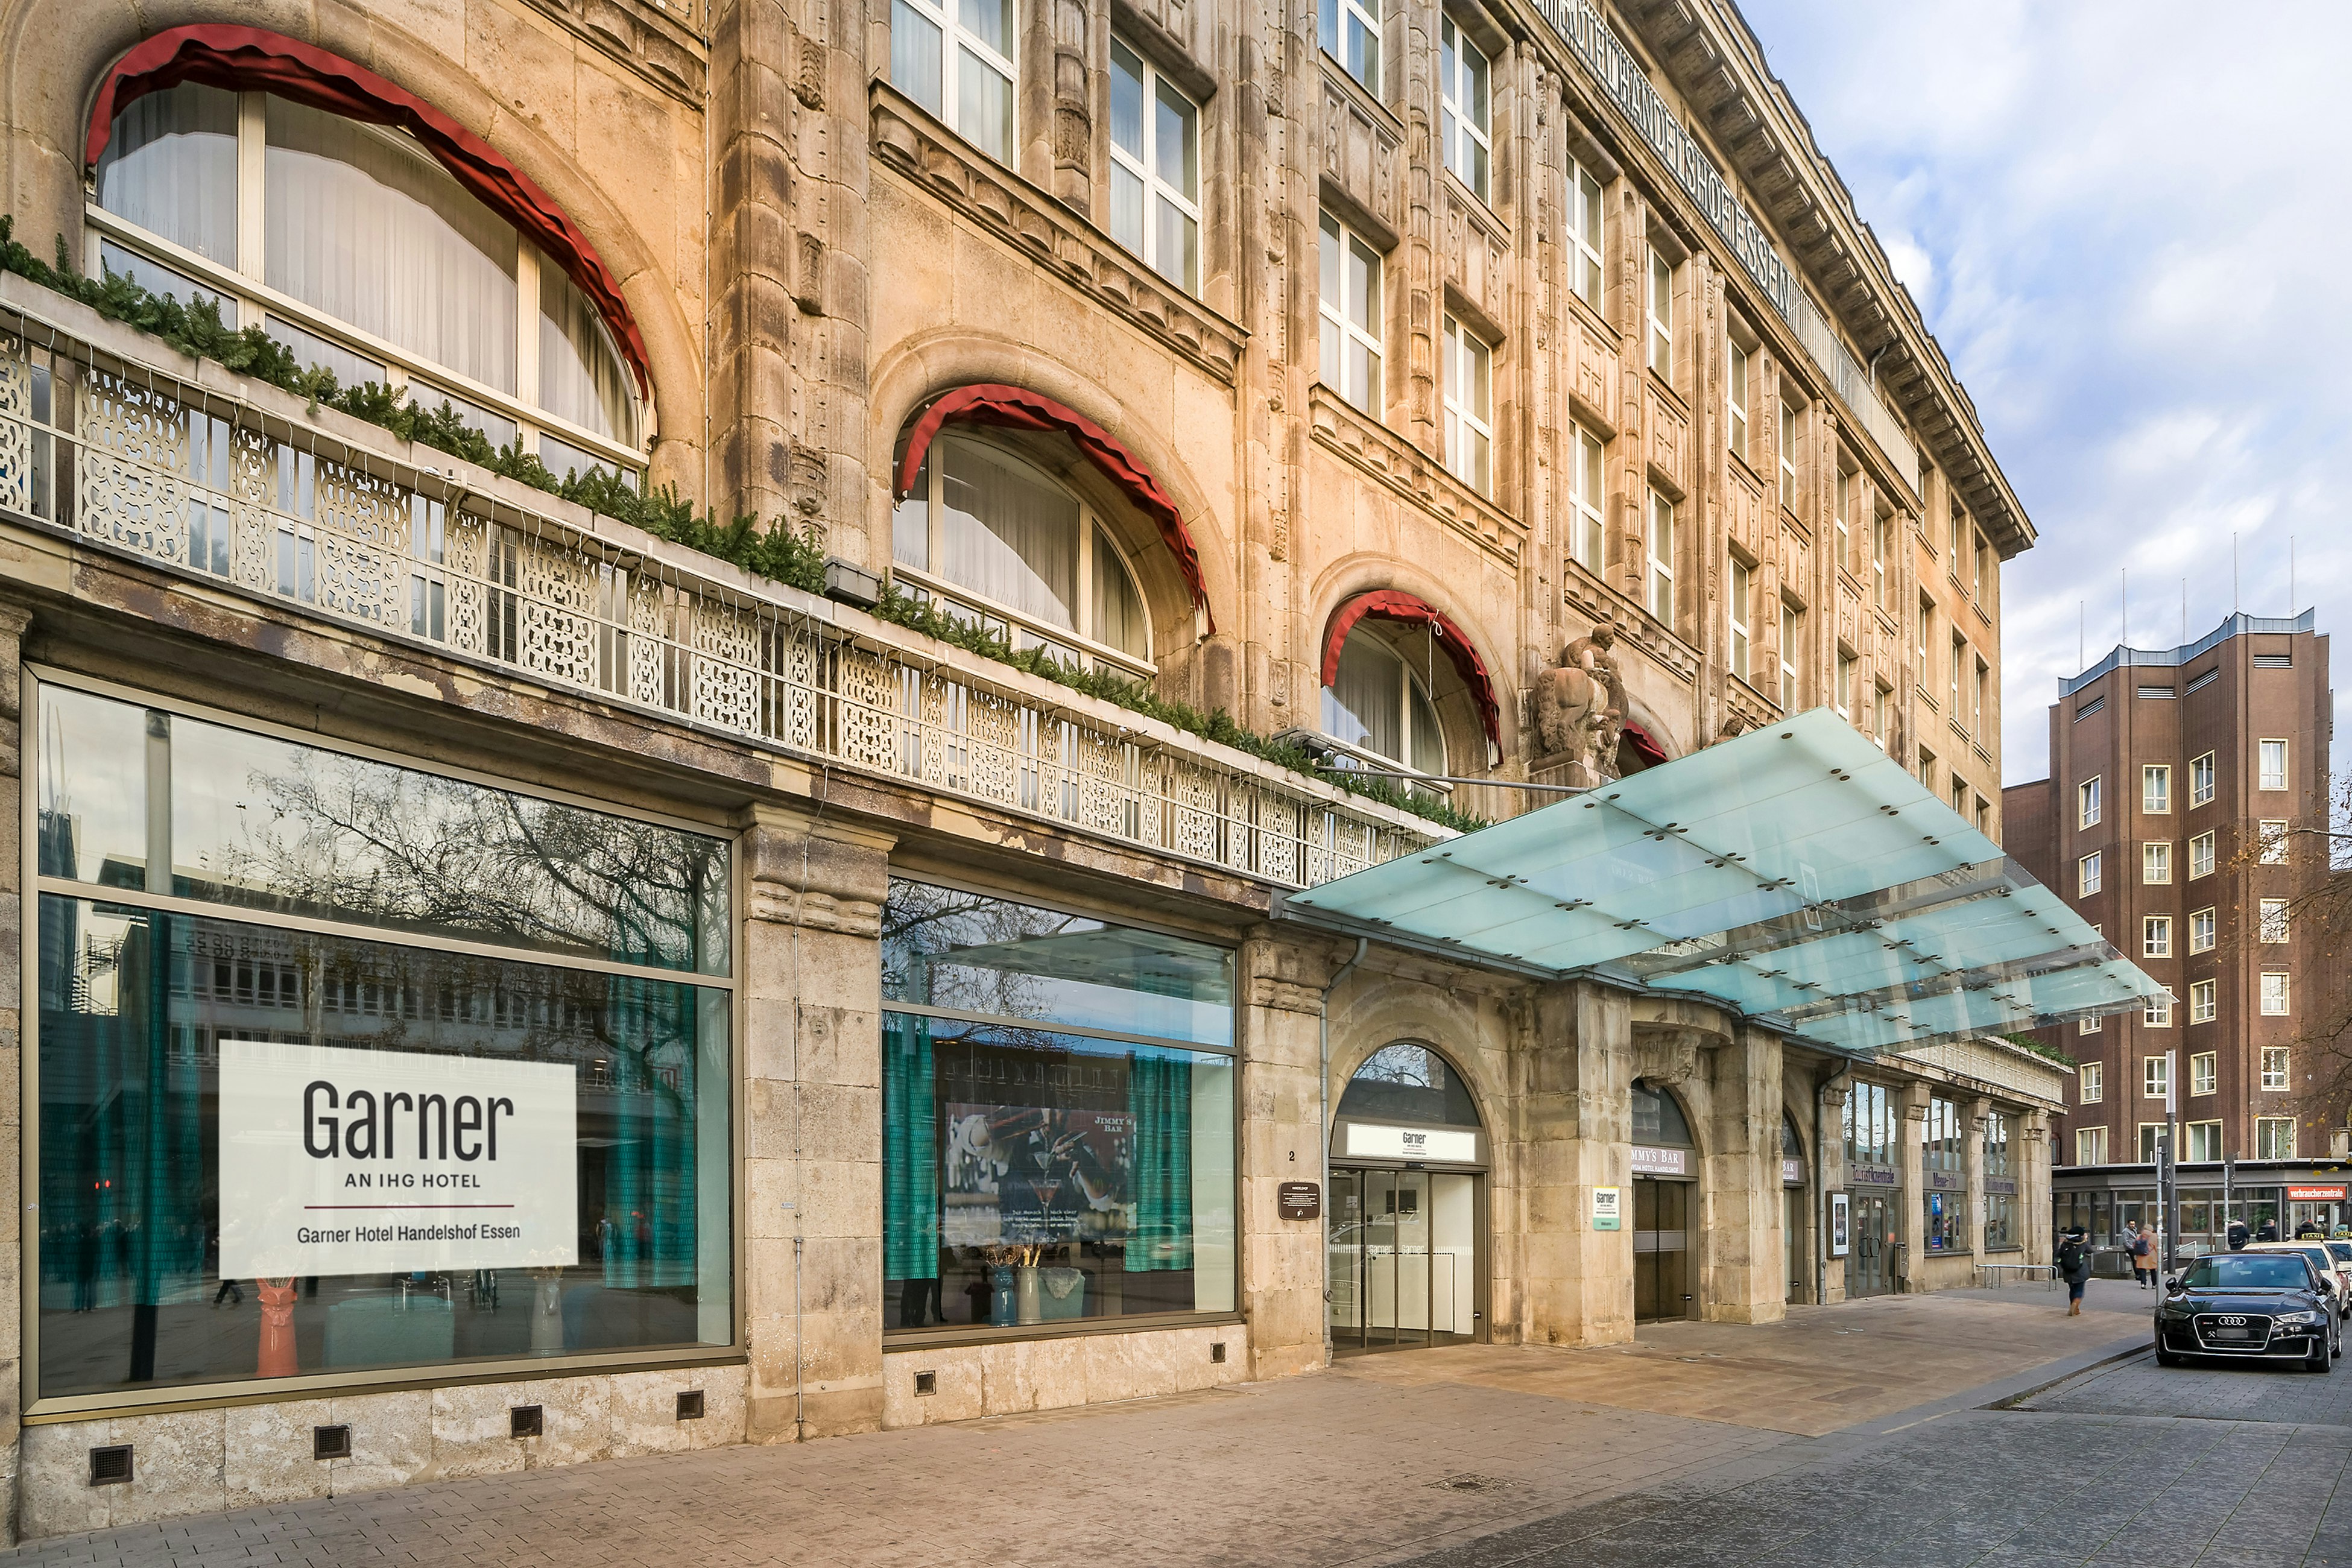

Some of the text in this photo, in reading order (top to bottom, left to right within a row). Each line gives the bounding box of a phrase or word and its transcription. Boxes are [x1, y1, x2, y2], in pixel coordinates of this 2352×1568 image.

[1619, 52, 1731, 236] HANDELSHOF
[1736, 204, 1791, 322] ESSEN
[304, 1080, 514, 1162] Garner
[1403, 1132, 1426, 1144] Garner
[1289, 1151, 1295, 1162] 2
[1661, 1150, 1678, 1164] BAR
[345, 1174, 481, 1188] AN IHG HOTEL
[1596, 1192, 1616, 1203] Garner
[2290, 1189, 2343, 1198] verbraucherzentrale
[297, 1224, 520, 1243] Garner Hotel Handelshof Essen
[1370, 1245, 1393, 1254] Garner
[1401, 1245, 1424, 1254] Garner
